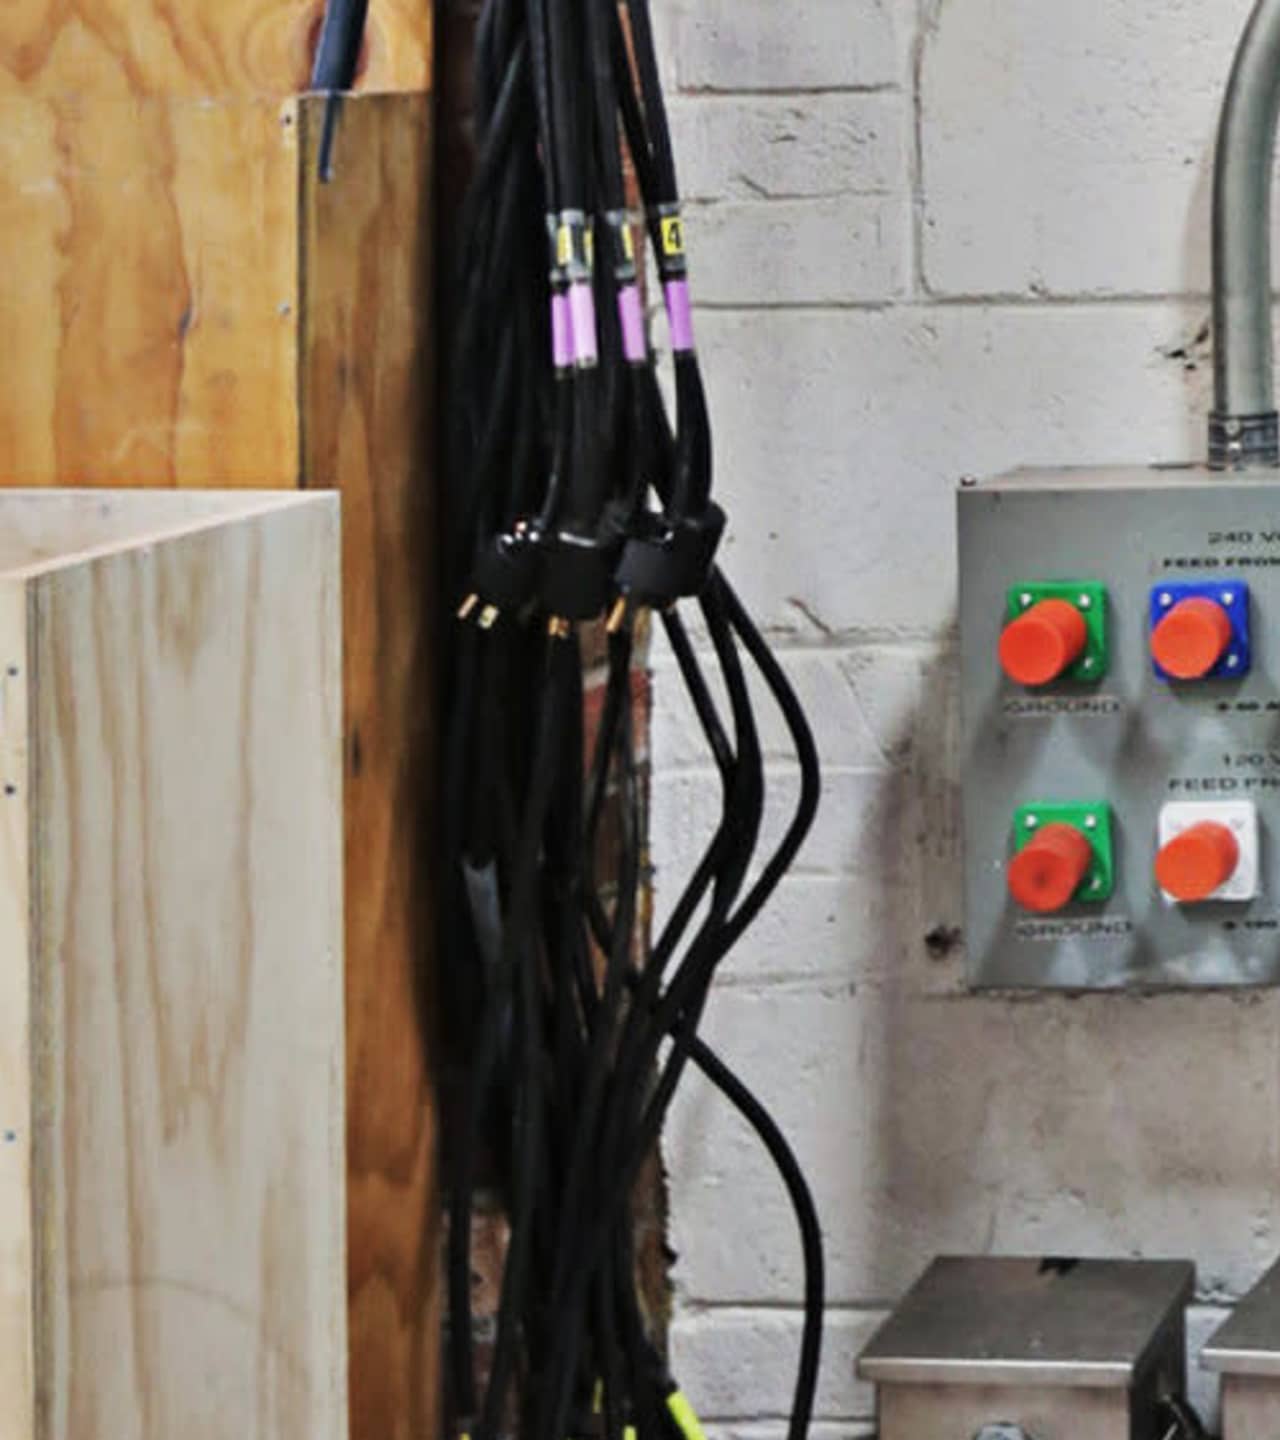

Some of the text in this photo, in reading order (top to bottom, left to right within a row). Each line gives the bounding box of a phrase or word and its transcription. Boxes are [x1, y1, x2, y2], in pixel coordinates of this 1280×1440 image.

[1207, 529, 1253, 544] 240
[1162, 556, 1220, 568] FEED
[1222, 752, 1265, 766] 120
[1168, 777, 1238, 790] FEED
